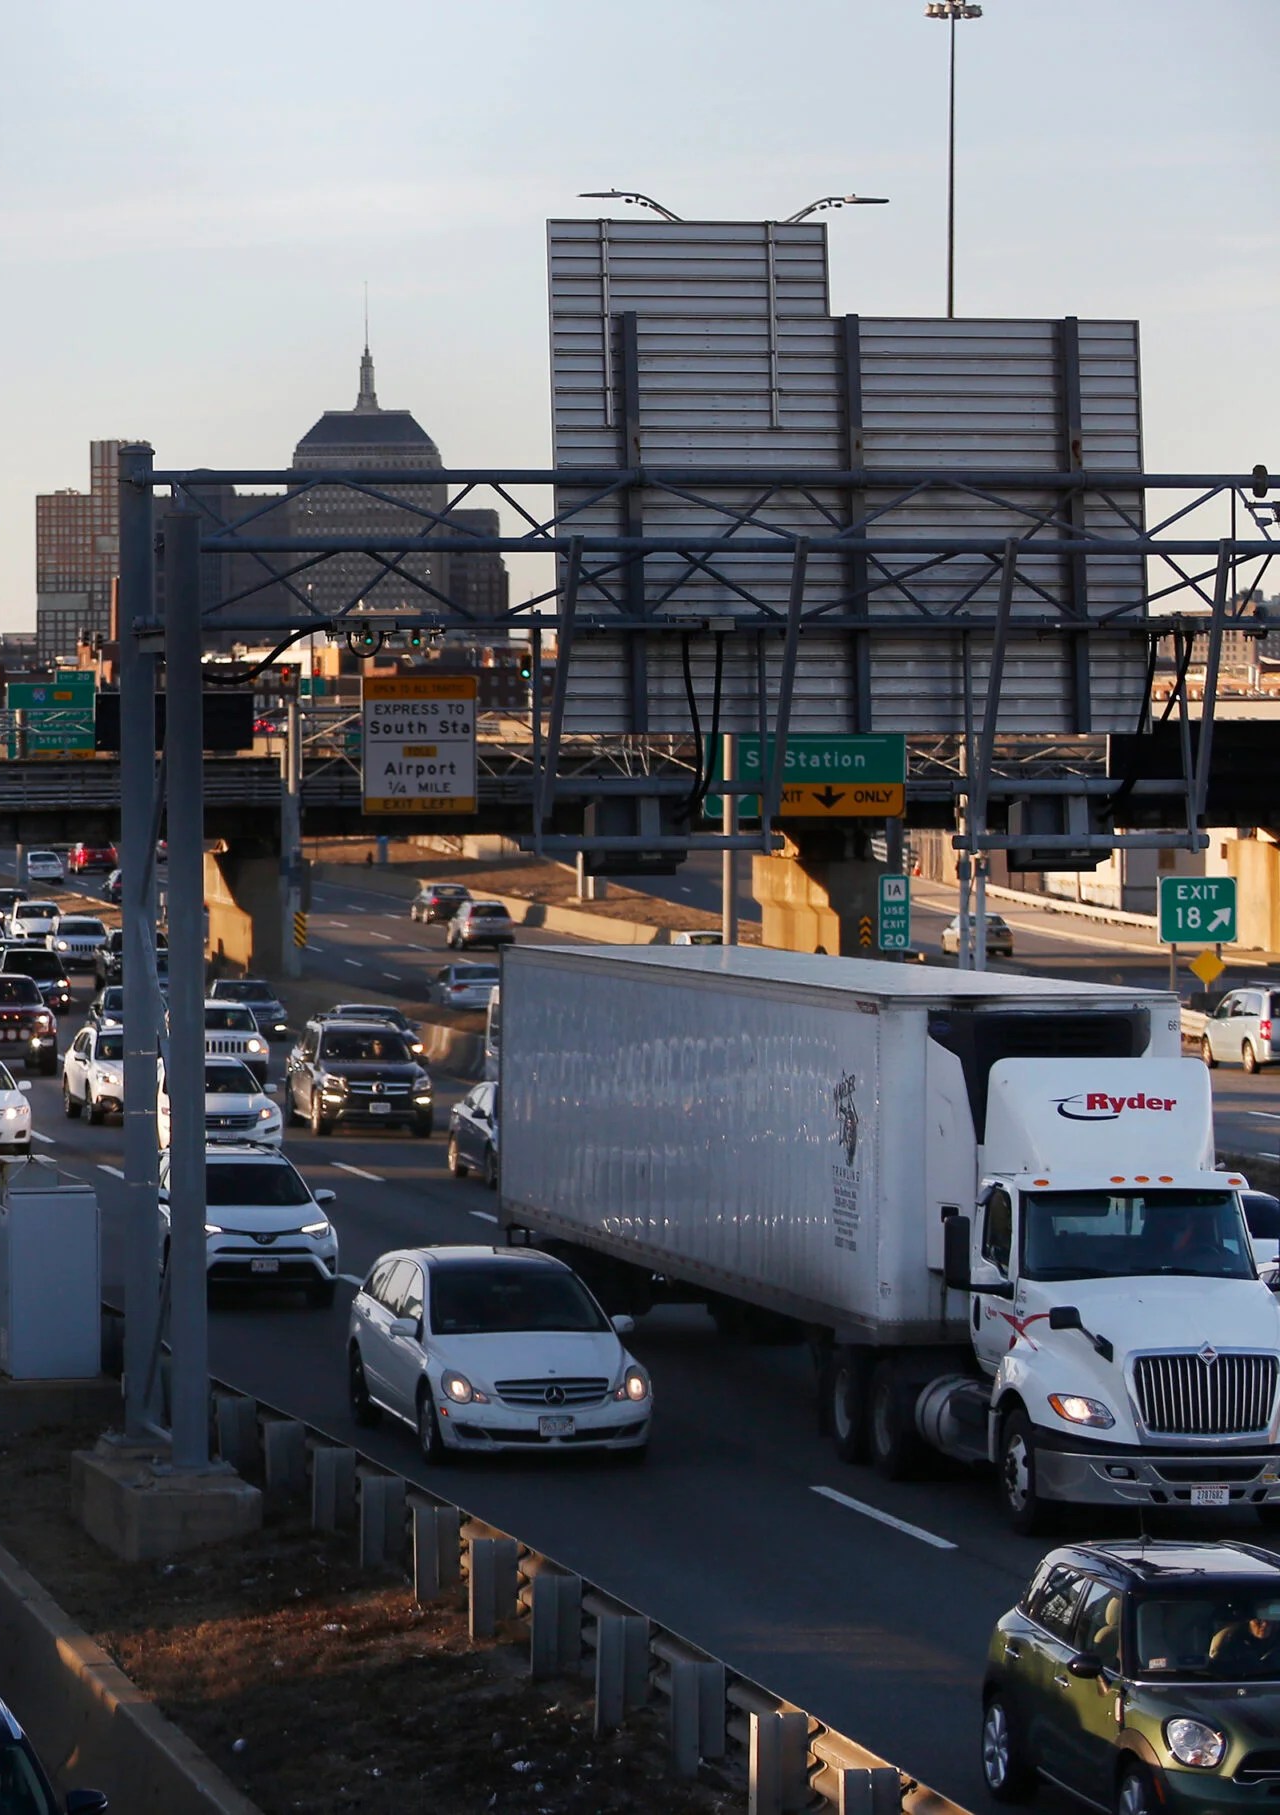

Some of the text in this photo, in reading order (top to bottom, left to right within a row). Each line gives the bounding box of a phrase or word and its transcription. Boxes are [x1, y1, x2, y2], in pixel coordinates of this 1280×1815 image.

[374, 703, 465, 715] EXPRESS TO
[369, 719, 471, 735] South Sta
[784, 750, 867, 768] Station
[383, 761, 457, 778] Airport
[417, 781, 452, 793] MILE
[853, 789, 894, 804] ONLY
[382, 798, 457, 810] EXIT LEFT
[887, 883, 902, 897] 1A
[1176, 884, 1220, 900] EXIT
[883, 905, 906, 916] USE
[1175, 905, 1202, 930] 18
[882, 919, 907, 929] EXIT
[883, 933, 906, 947] 20
[1086, 1092, 1178, 1114] Ryder
